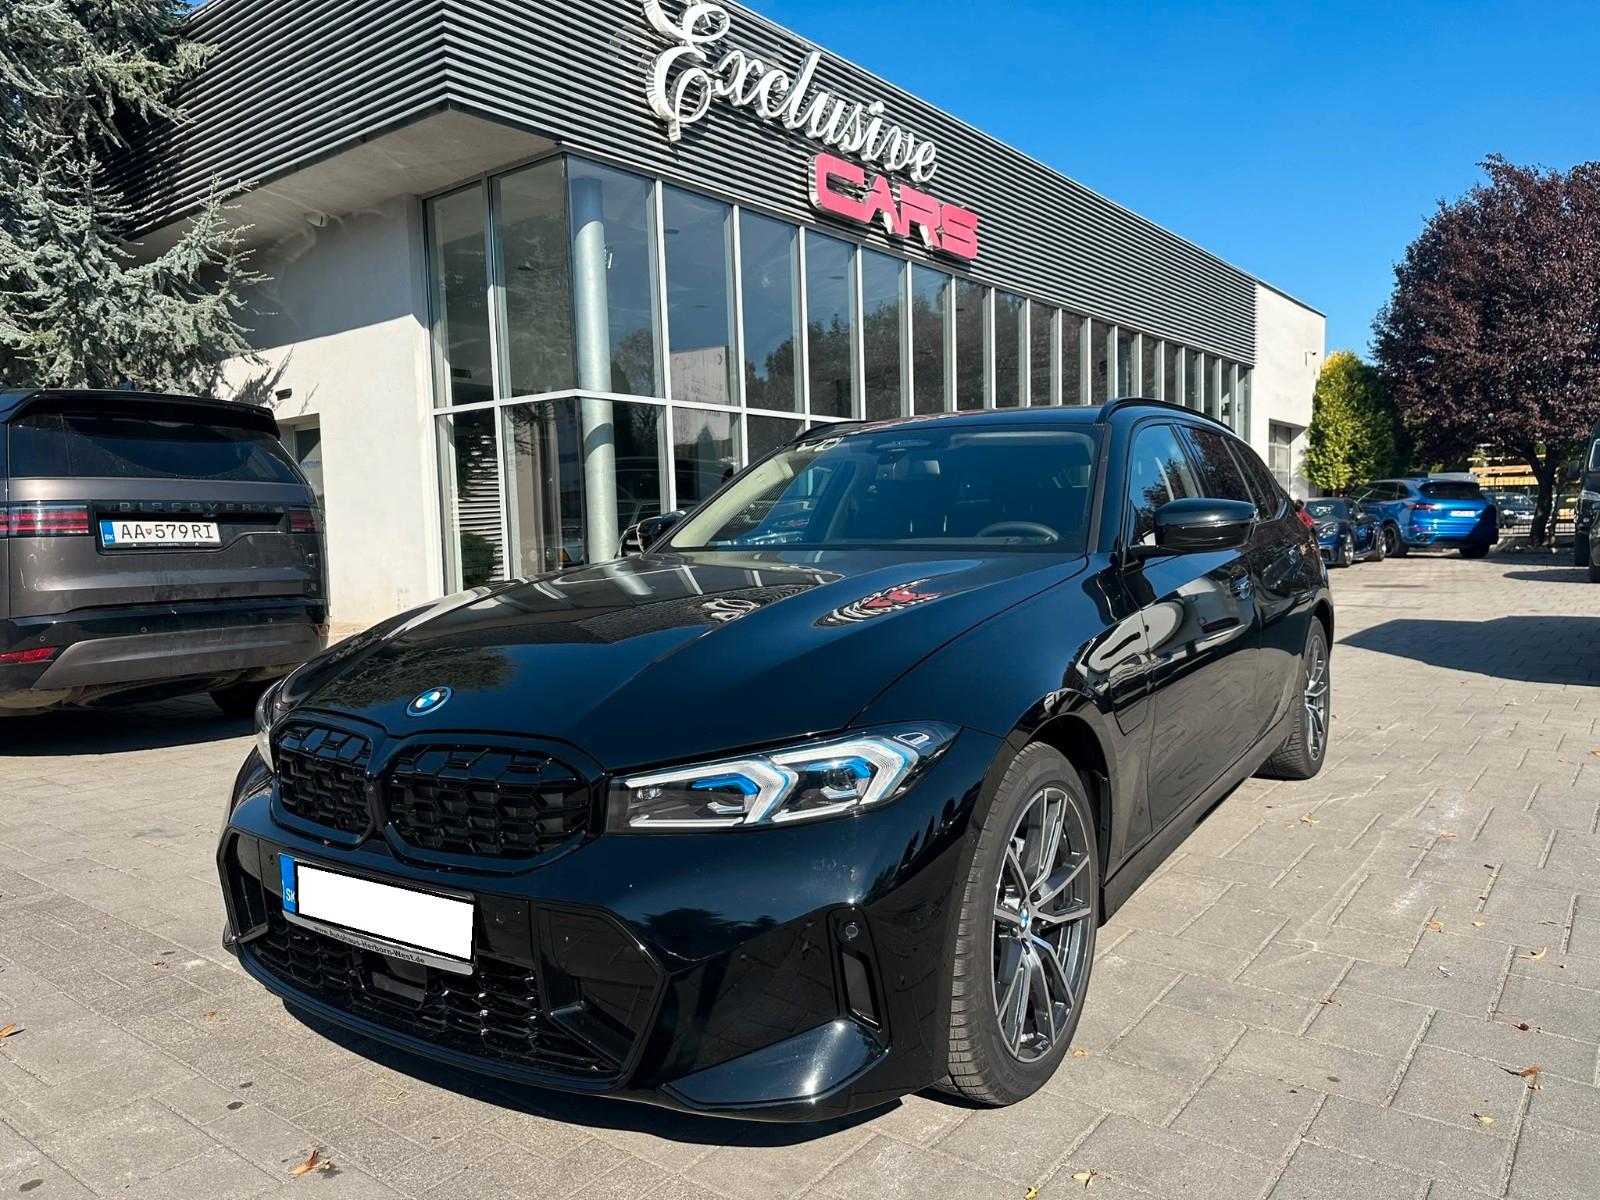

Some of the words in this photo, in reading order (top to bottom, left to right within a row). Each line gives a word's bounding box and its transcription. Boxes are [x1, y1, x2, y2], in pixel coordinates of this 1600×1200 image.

[642, 0, 938, 183] Exclusive
[808, 152, 978, 260] CARS
[119, 502, 267, 512] DISCOVERY
[285, 887, 296, 904] SK
